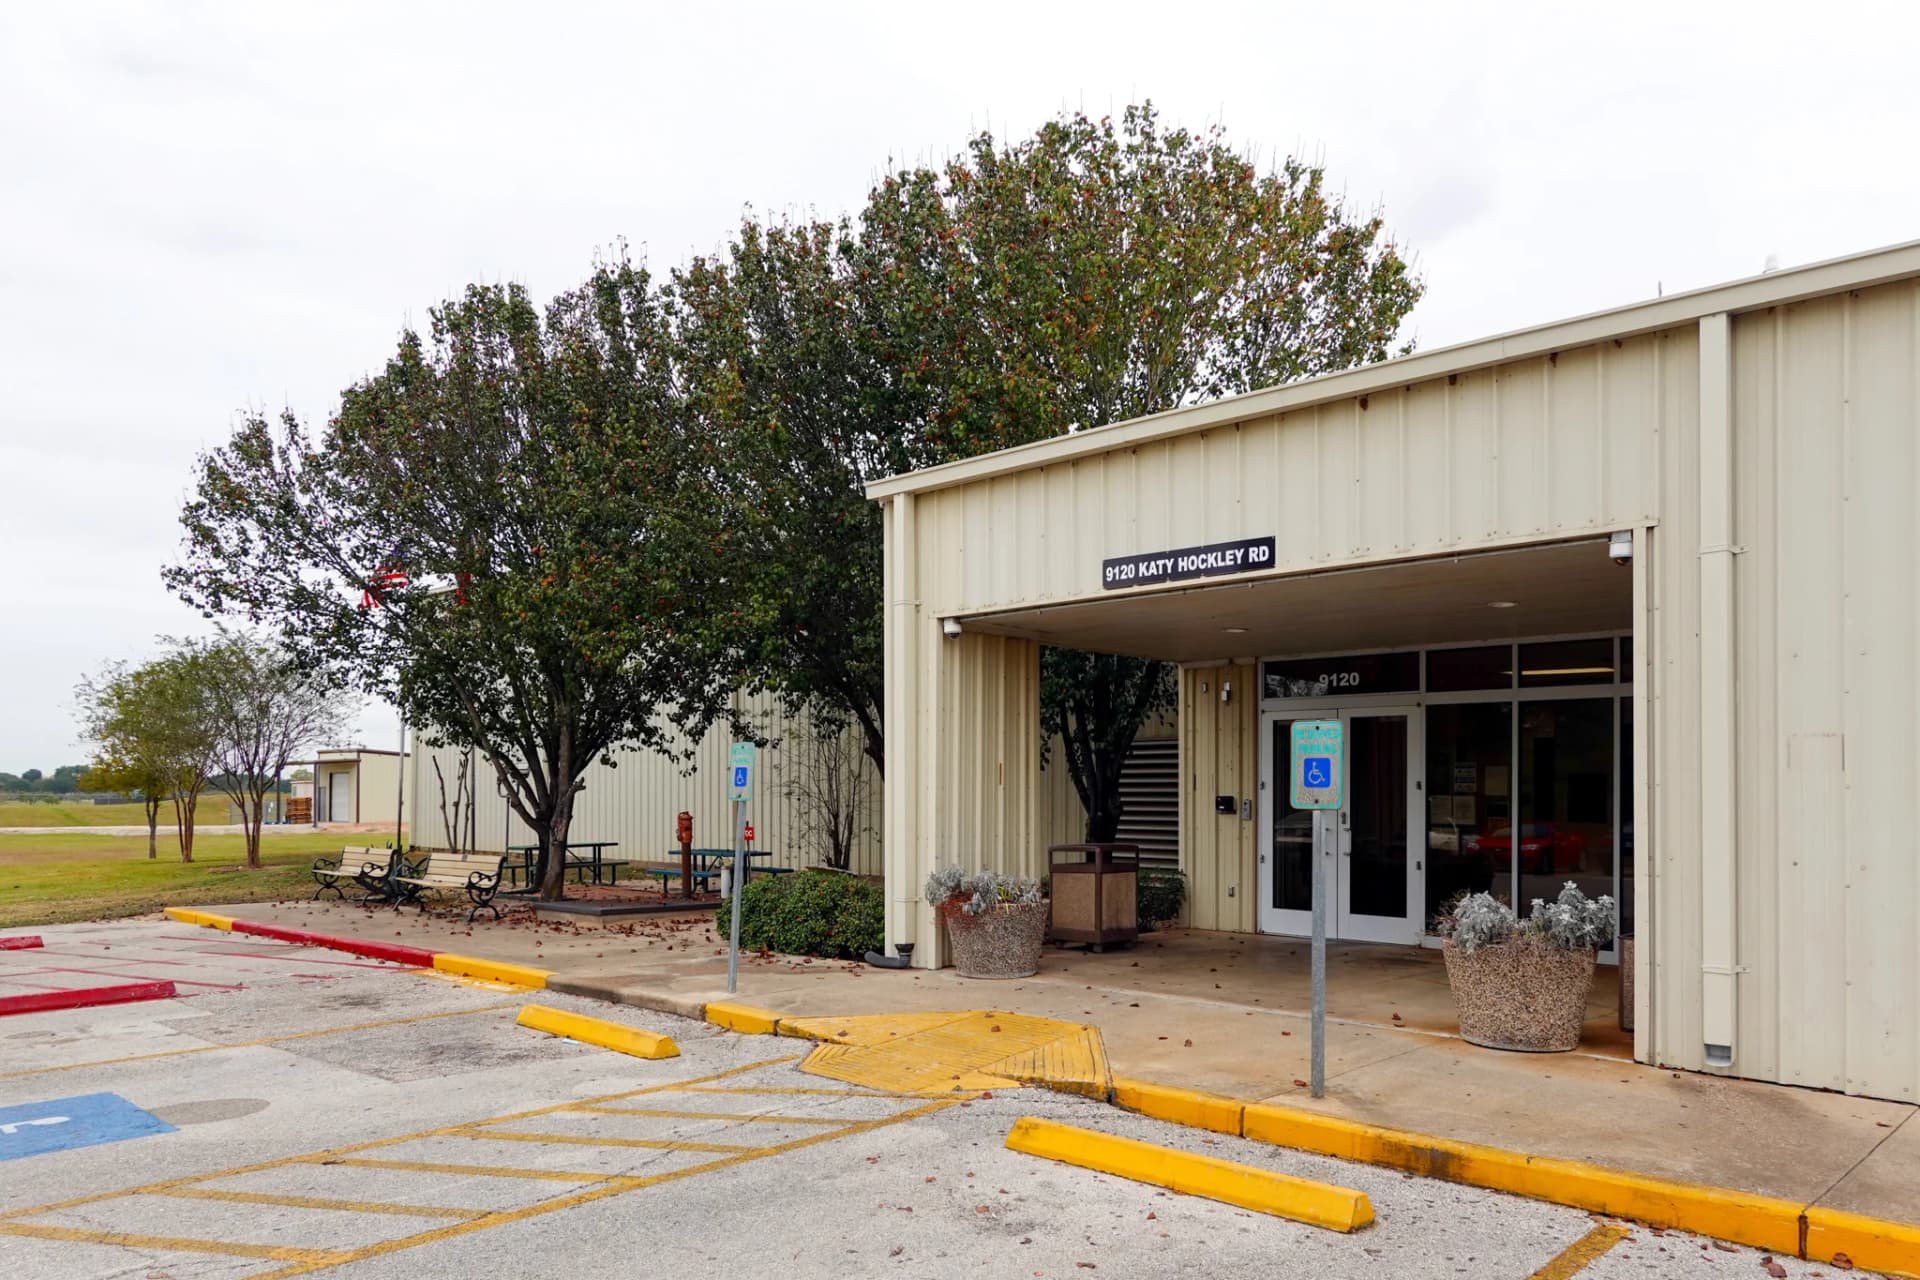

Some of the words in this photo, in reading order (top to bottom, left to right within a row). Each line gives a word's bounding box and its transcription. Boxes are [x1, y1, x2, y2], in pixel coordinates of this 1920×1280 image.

[1106, 563, 1135, 581] 9120
[1138, 558, 1175, 577] KATY
[1178, 548, 1245, 572] HOCKLEY
[1248, 545, 1269, 563] RD
[1319, 672, 1360, 687] 9120
